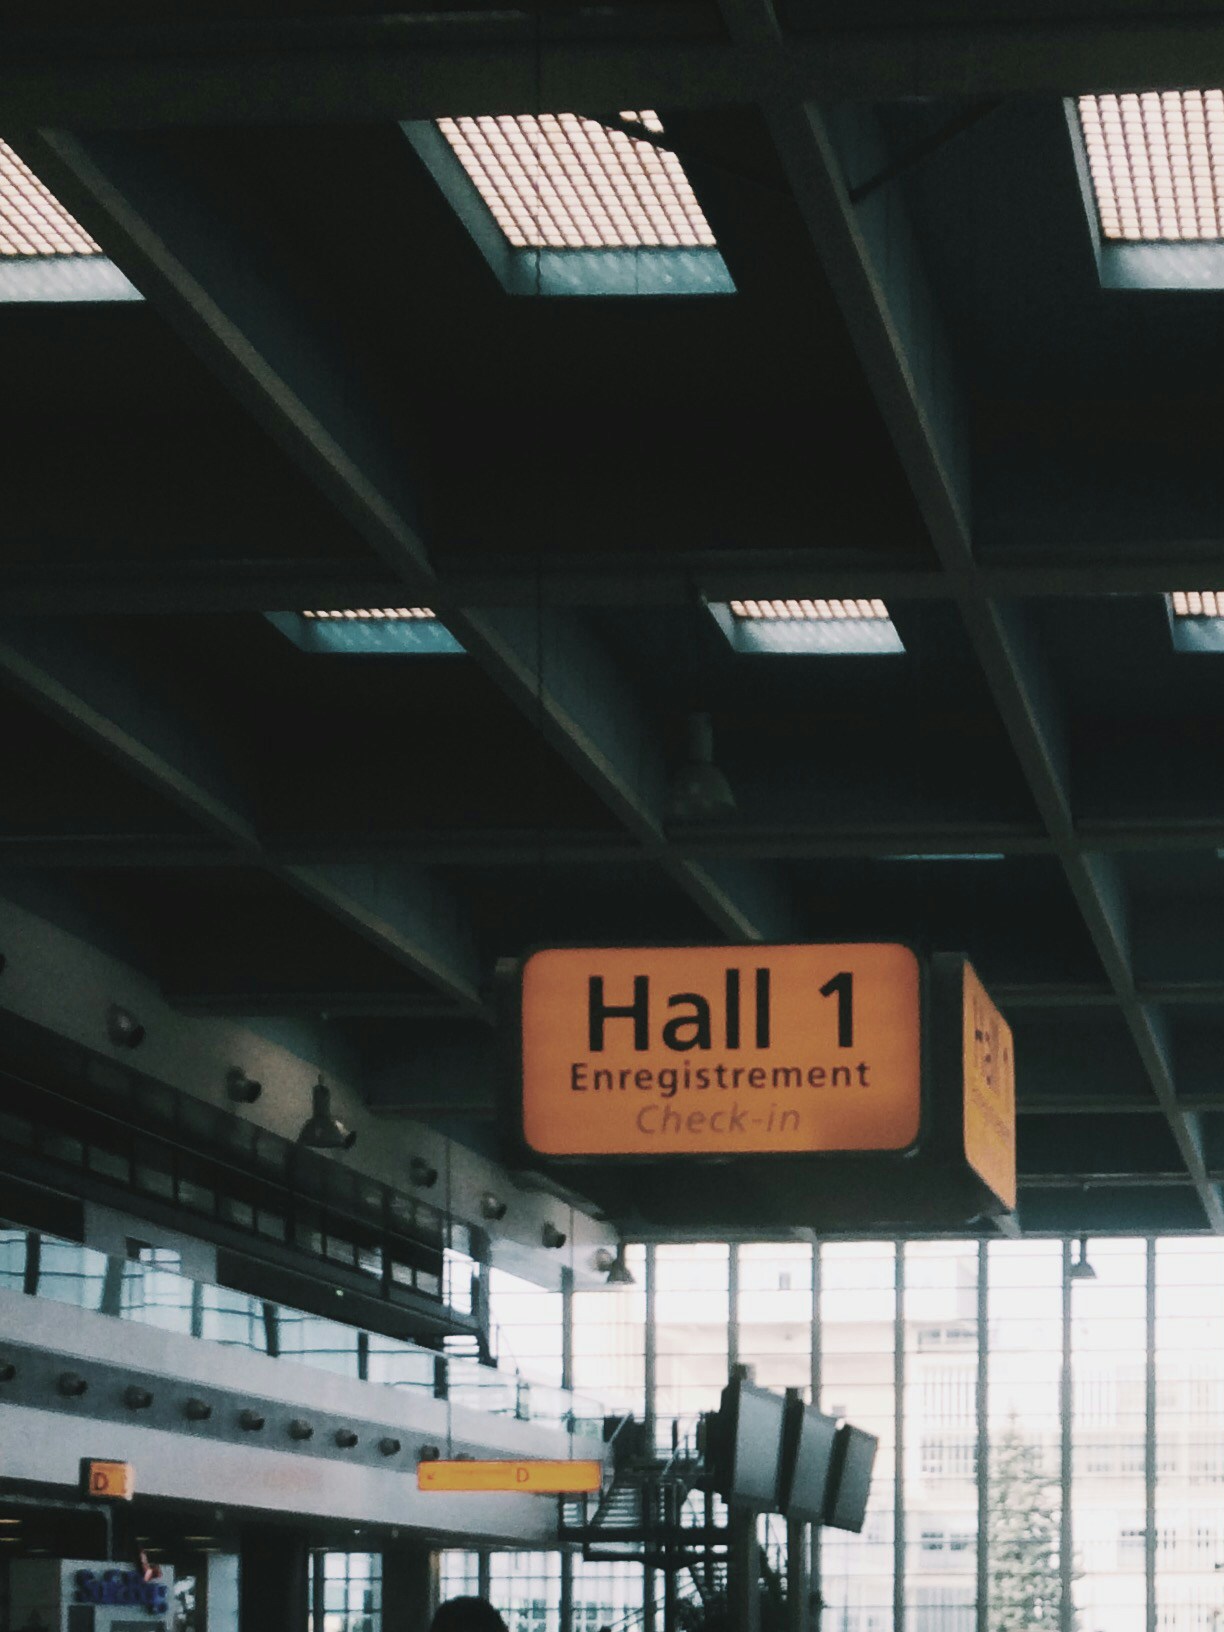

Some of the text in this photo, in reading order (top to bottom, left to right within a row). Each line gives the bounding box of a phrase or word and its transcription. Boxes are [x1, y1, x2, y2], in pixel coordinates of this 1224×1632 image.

[588, 968, 853, 1051] Hall 1
[570, 1061, 870, 1098] Enregistrement
[636, 1103, 800, 1136] Check-in
[516, 1467, 530, 1482] D
